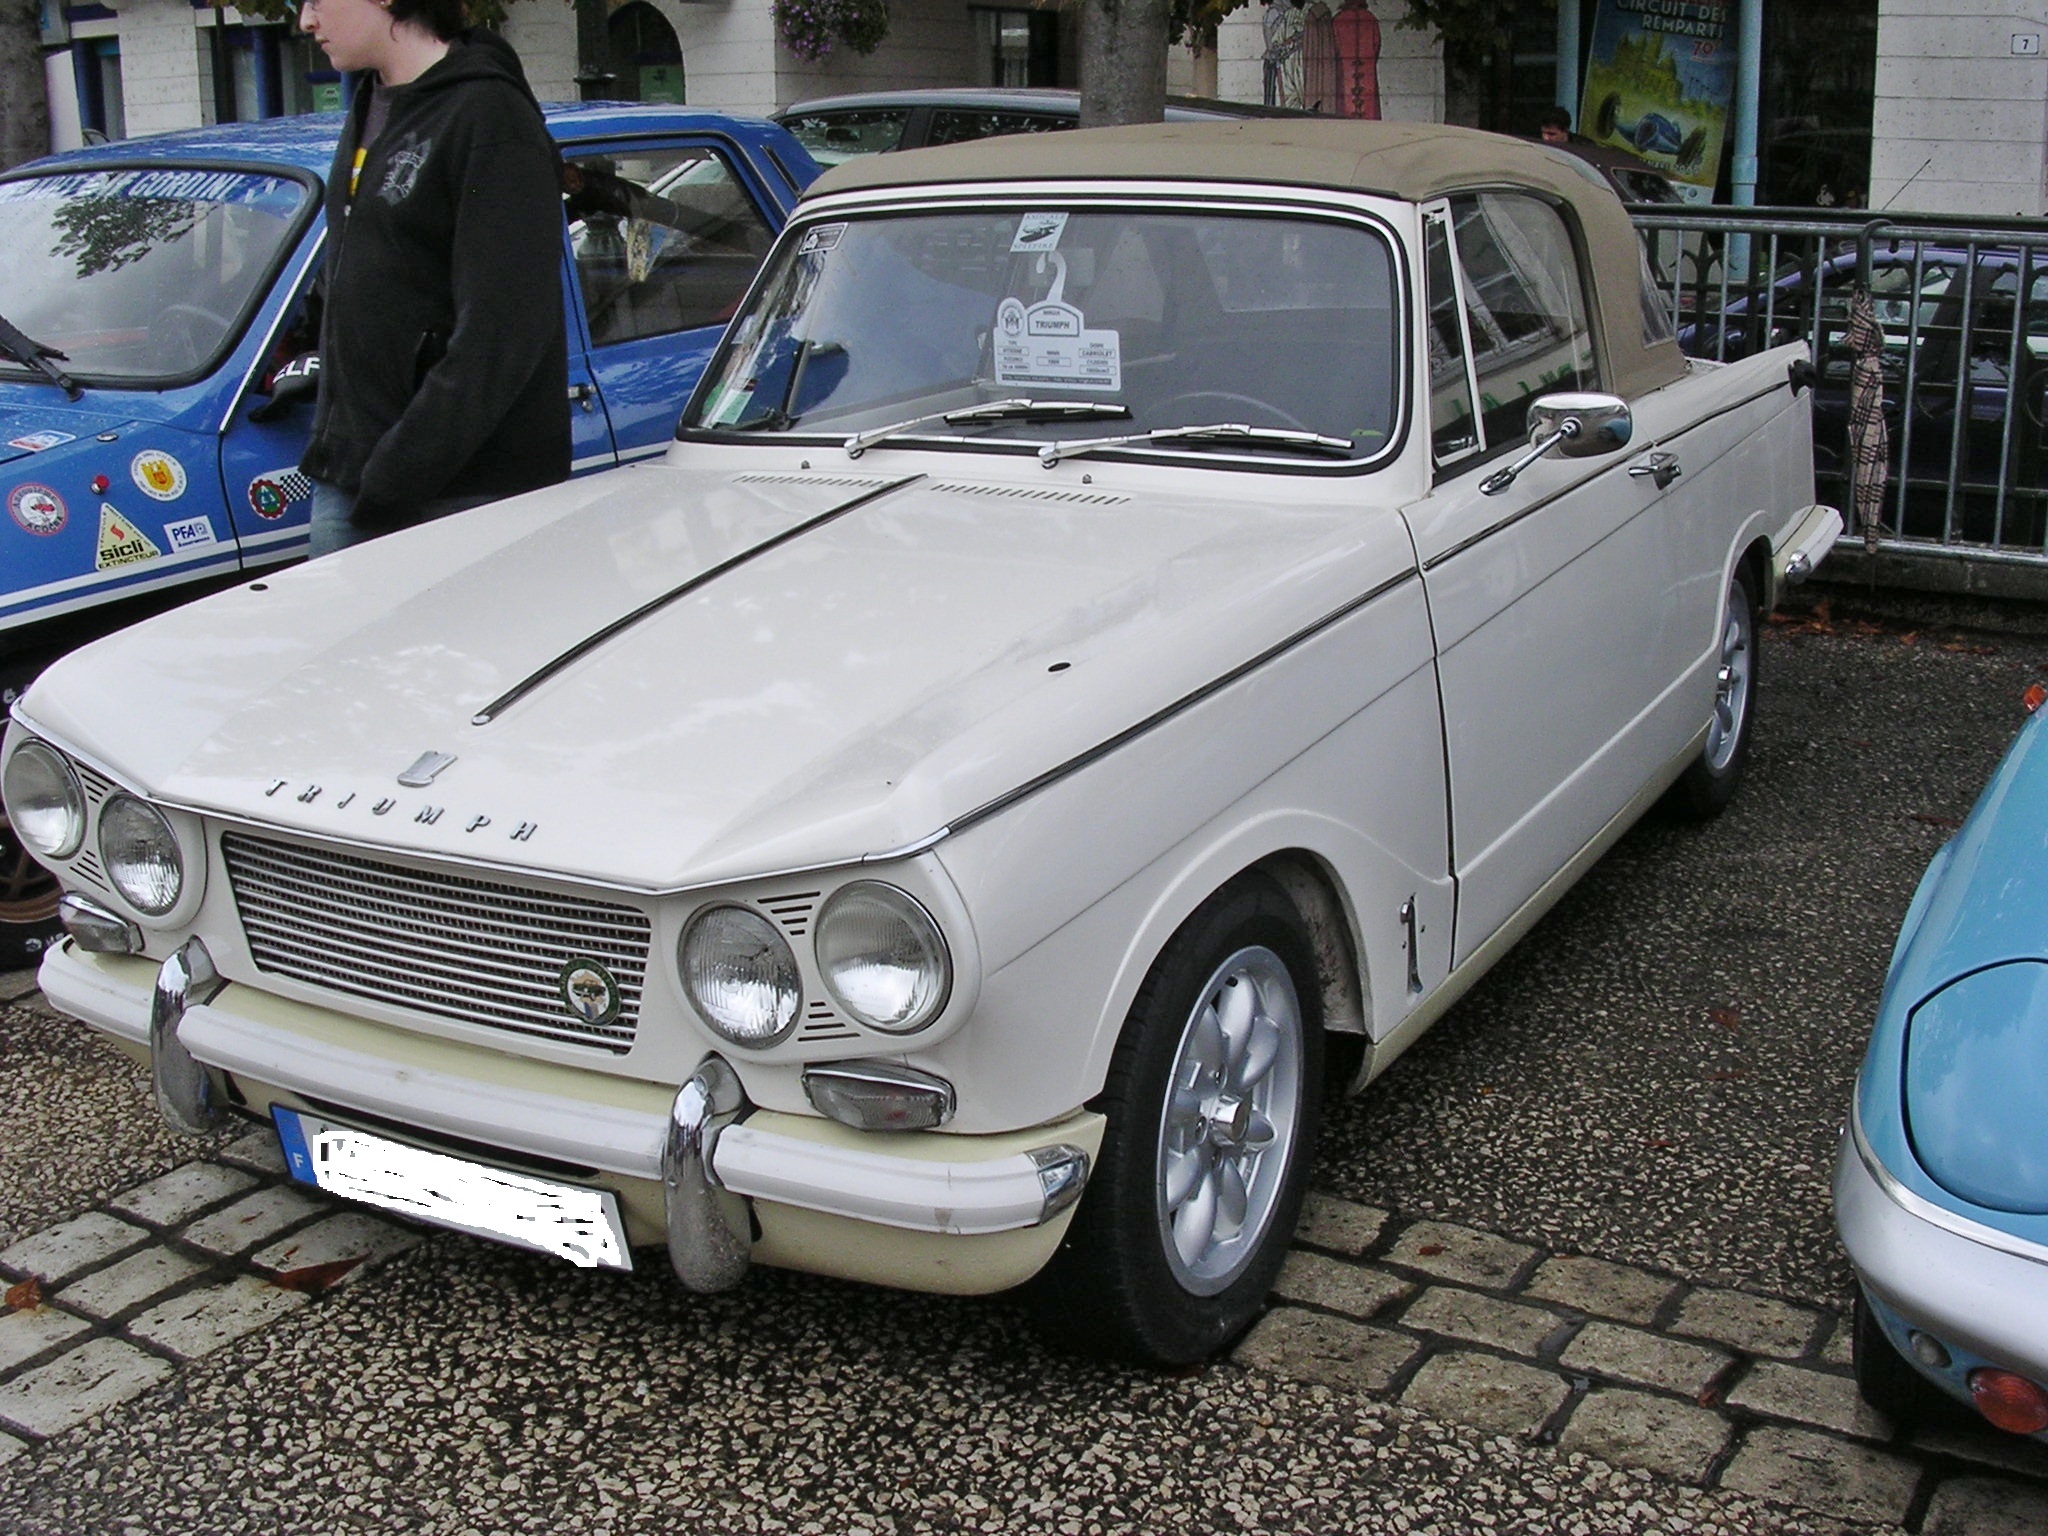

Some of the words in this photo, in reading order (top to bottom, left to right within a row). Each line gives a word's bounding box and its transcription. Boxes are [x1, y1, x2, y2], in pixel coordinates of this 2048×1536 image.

[1617, 0, 1687, 17] CIRCUIT
[2022, 38, 2029, 50] 7
[128, 170, 246, 200] GORDINI
[1035, 320, 1071, 330] TRIUMPH
[172, 524, 196, 541] PFA
[98, 549, 159, 569] EXTINCTEUR
[264, 778, 538, 842] TRIUMPH
[292, 1151, 304, 1169] F
